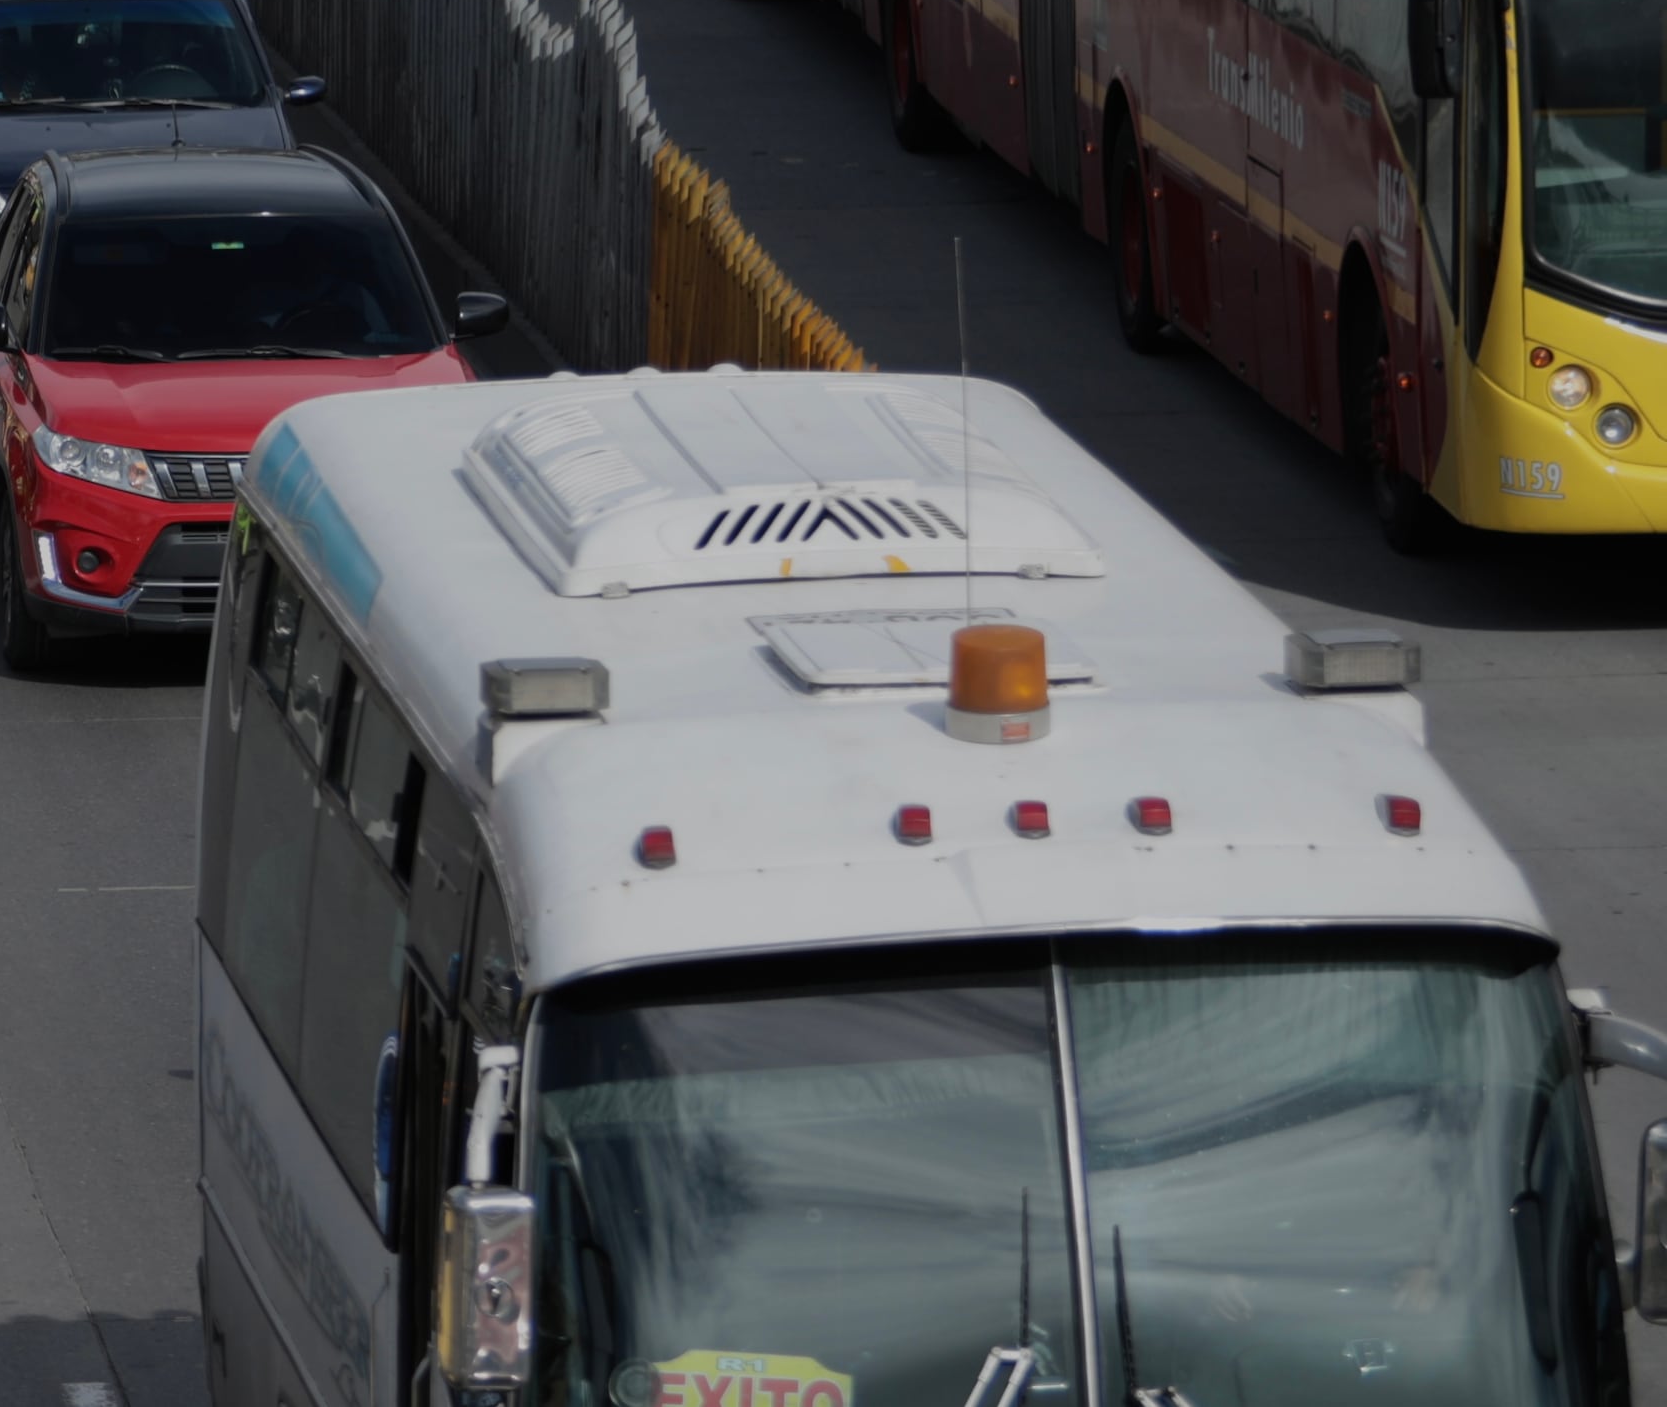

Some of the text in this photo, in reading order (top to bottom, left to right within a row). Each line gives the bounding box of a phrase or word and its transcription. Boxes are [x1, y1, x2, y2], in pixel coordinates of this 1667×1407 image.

[1207, 25, 1304, 150] TransMilenio
[1499, 457, 1562, 491] N159
[654, 1373, 844, 1407] EXITO
